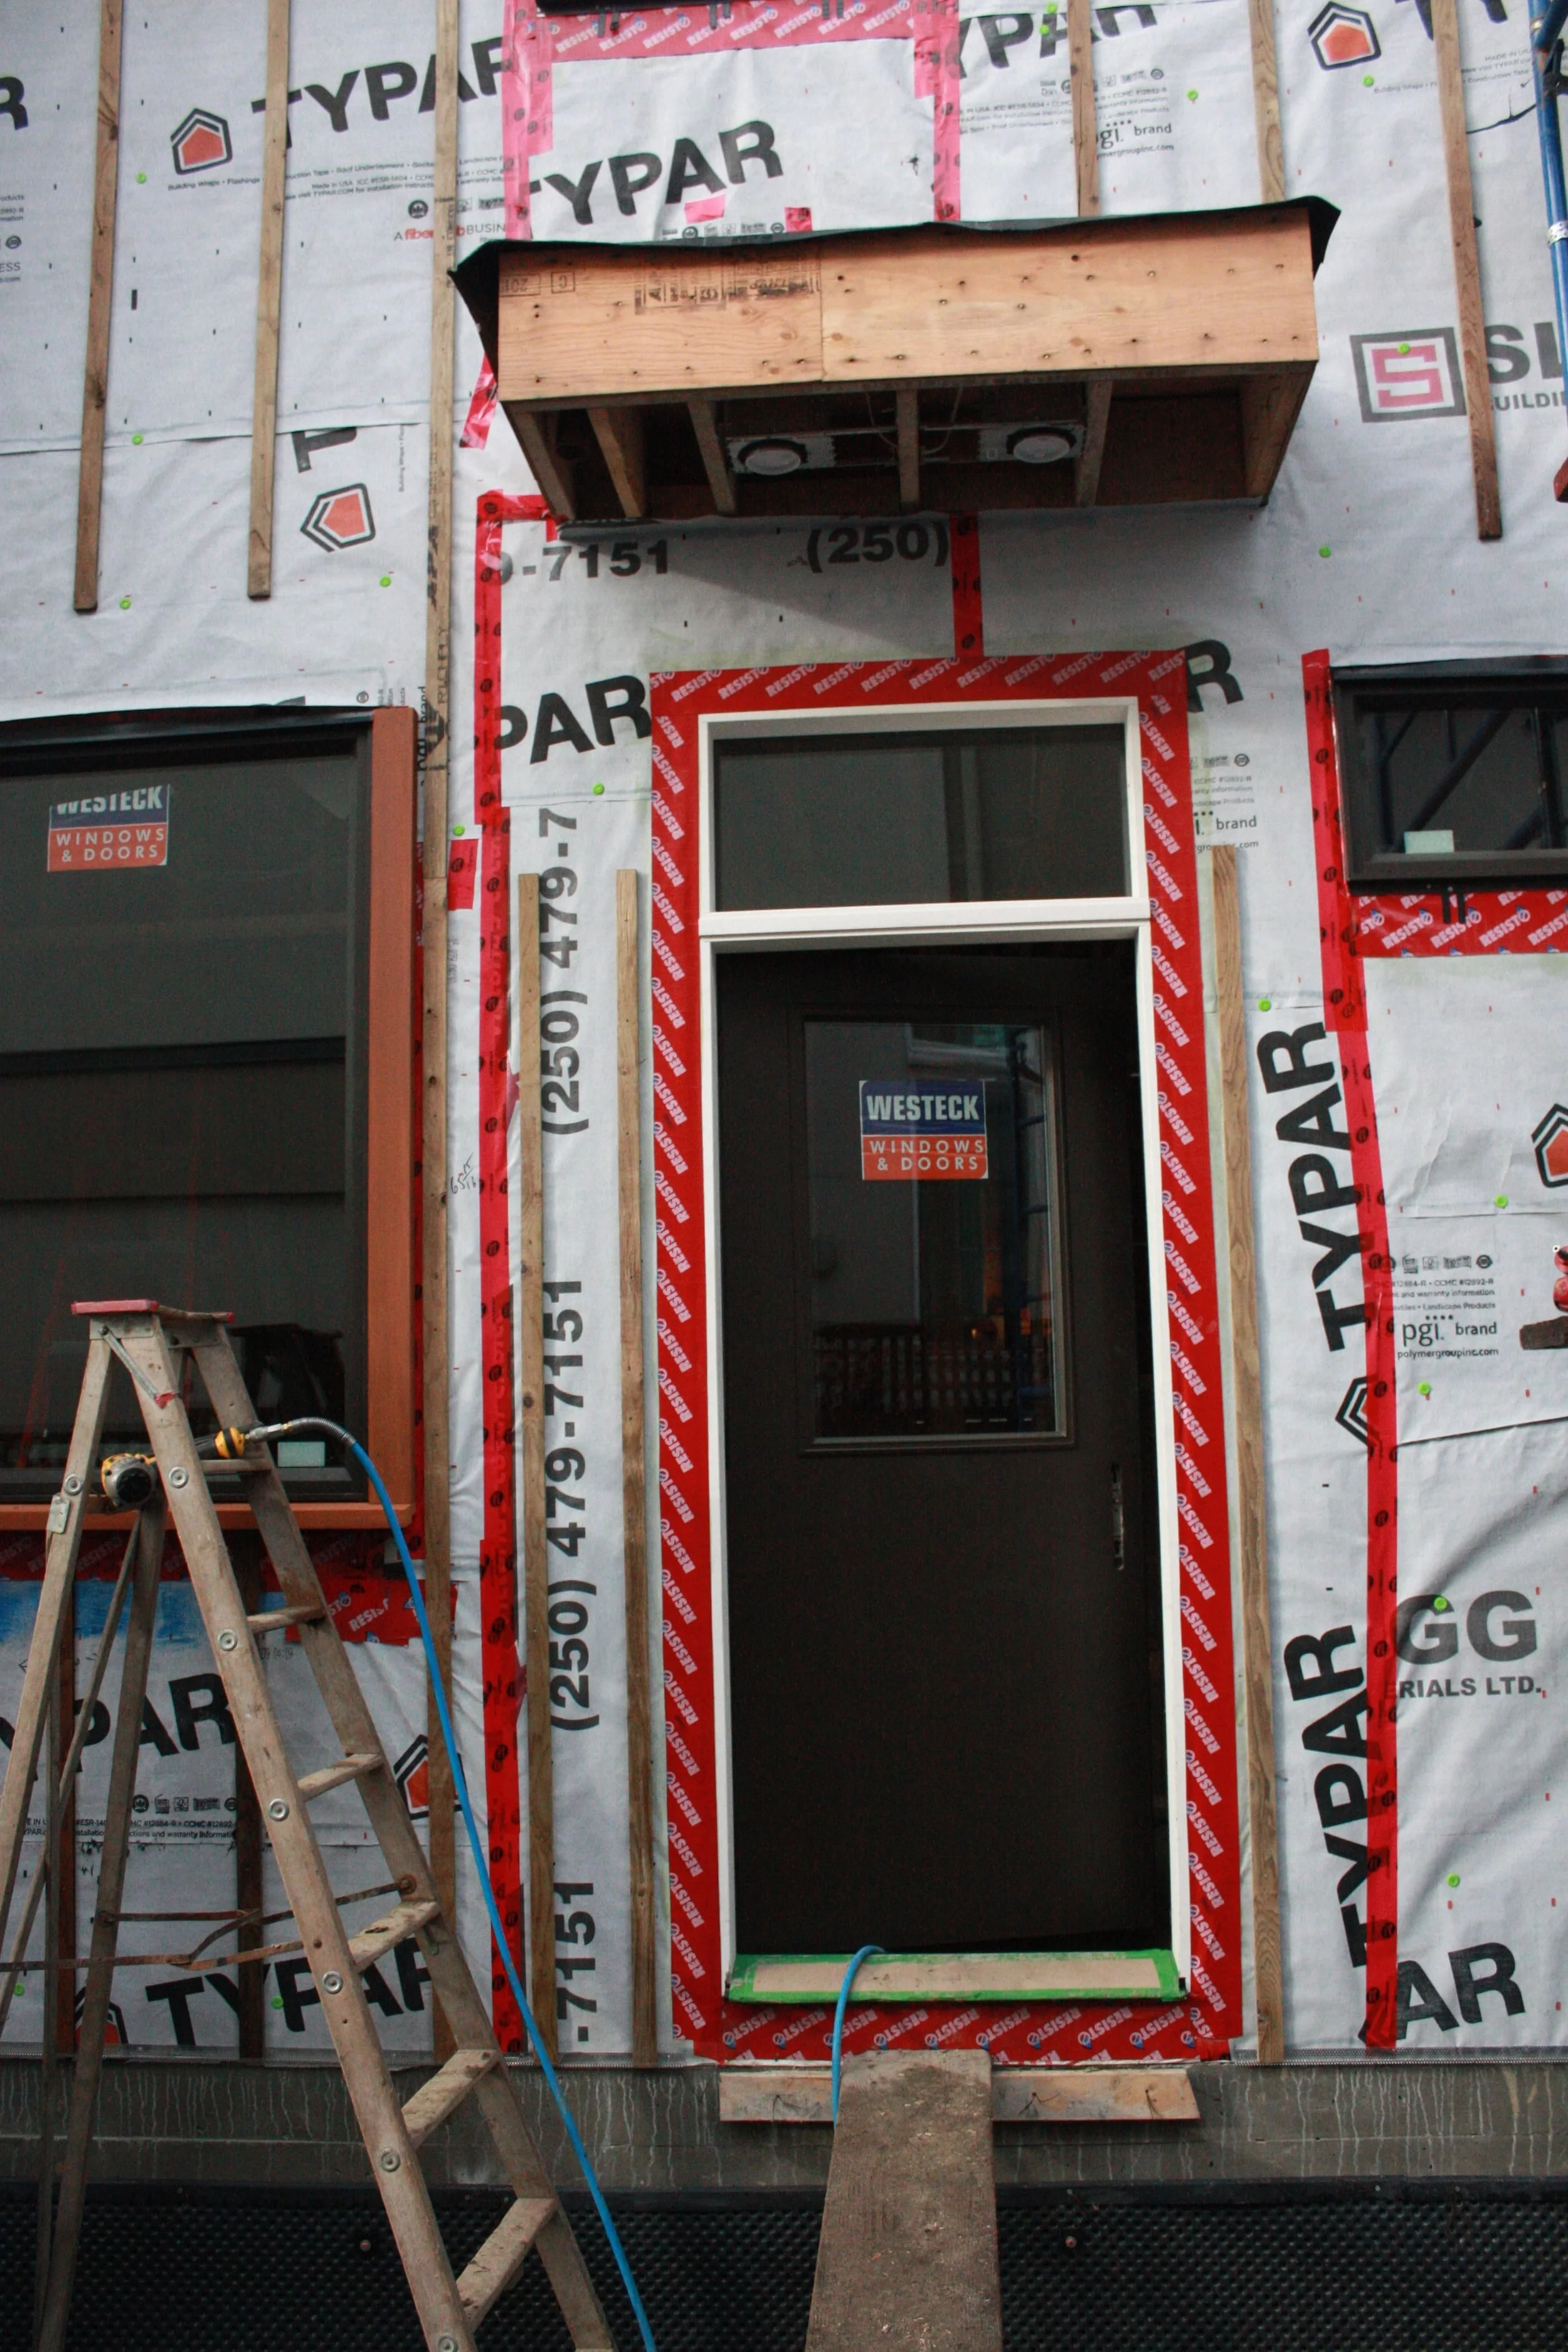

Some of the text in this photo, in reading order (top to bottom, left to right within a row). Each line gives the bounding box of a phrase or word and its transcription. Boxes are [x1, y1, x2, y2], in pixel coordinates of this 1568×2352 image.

[599, 20, 647, 51] RESISTO
[642, 16, 691, 49] RESISTO
[730, 9, 778, 41] RESISTO
[774, 7, 822, 38] RESISTO
[1133, 122, 1172, 136] brand
[531, 120, 783, 226] YPAR
[807, 522, 949, 573] (250)
[1139, 712, 1173, 760] RESISTO
[652, 744, 684, 794] RESISTO
[1142, 758, 1177, 807] RESISTO
[56, 828, 164, 846] WINDOWS
[652, 789, 684, 840] RESISTO
[1144, 804, 1179, 853] RESISTO
[1216, 815, 1258, 830] brand
[61, 845, 157, 862] & DOORS
[652, 836, 684, 887] RESISTO
[1147, 851, 1182, 901] RESISTO
[652, 882, 684, 933] RESISTO
[1149, 898, 1184, 948] RESISTO
[1382, 912, 1433, 949] RESISTO
[1478, 909, 1530, 947] RESISTO
[652, 930, 685, 981] RESISTO
[1151, 945, 1187, 997] RESISTO
[653, 977, 685, 1029] RESISTO
[1153, 993, 1189, 1046] RESISTO
[541, 990, 589, 1135] (250)
[653, 1025, 686, 1076] RESISTO
[1155, 1042, 1191, 1094] RESISTO
[653, 1073, 687, 1125] RESISTO
[866, 1095, 980, 1120] WESTECK
[1157, 1091, 1193, 1144] RESISTO
[654, 1121, 687, 1173] RESISTO
[869, 1140, 983, 1153] WINDOWS
[877, 1157, 978, 1171] & DOORS
[1160, 1142, 1195, 1194] RESISTO
[654, 1170, 689, 1222] RESISTO
[1257, 1022, 1376, 1352] TYPAR
[1162, 1191, 1197, 1243] RESISTO
[655, 1220, 690, 1273] RESISTO
[1165, 1241, 1200, 1293] RESISTO
[655, 1269, 691, 1322] RESISTO
[1167, 1291, 1203, 1343] RESISTO
[1451, 1288, 1495, 1296] information
[1463, 1301, 1496, 1310] Products
[656, 1319, 691, 1372] RESISTO
[1397, 1347, 1499, 1360] polymergroupinc.com
[1455, 1321, 1498, 1336] brand
[1170, 1342, 1205, 1394] RESISTO
[657, 1369, 692, 1422] RESISTO
[1172, 1392, 1208, 1445] RESISTO
[658, 1419, 693, 1472] RESISTO
[1174, 1443, 1210, 1496] RESISTO
[543, 1281, 600, 1731] (250) 479-7151
[659, 1469, 694, 1522] RESISTO
[1176, 1494, 1212, 1547] RESISTO
[660, 1520, 695, 1573] RESISTO
[1179, 1545, 1214, 1599] RESISTO
[661, 1569, 696, 1623] RESISTO
[662, 1620, 697, 1674] RESISTO
[1180, 1596, 1216, 1650] RESISTO
[664, 1670, 698, 1724] RESISTO
[1182, 1648, 1217, 1701] RESISTO
[1486, 1676, 1542, 1696] LTD.
[665, 1720, 699, 1775] RESISTO
[1185, 1699, 1219, 1752] RESISTO
[667, 1771, 701, 1825] RESISTO
[1187, 1751, 1221, 1804] RESISTO
[668, 1821, 702, 1876] RESISTO
[1189, 1801, 1222, 1856] RESISTO
[669, 1872, 704, 1927] RESISTO
[1189, 1853, 1223, 1907] RESISTO
[670, 1922, 704, 1978] RESISTO
[1189, 1905, 1224, 1959] RESISTO
[672, 1973, 706, 2028] RESISTO
[1189, 1955, 1225, 2011] RESISTO
[723, 2008, 776, 2045] RESISTO
[773, 2008, 827, 2047] RESISTO
[874, 2009, 929, 2046] RESISTO
[924, 2008, 979, 2046] RESISTO
[976, 2008, 1030, 2046] RESISTO
[1027, 2008, 1081, 2045] RESISTO
[1078, 2007, 1133, 2045] RESISTO
[1129, 2006, 1184, 2045] RESISTO
